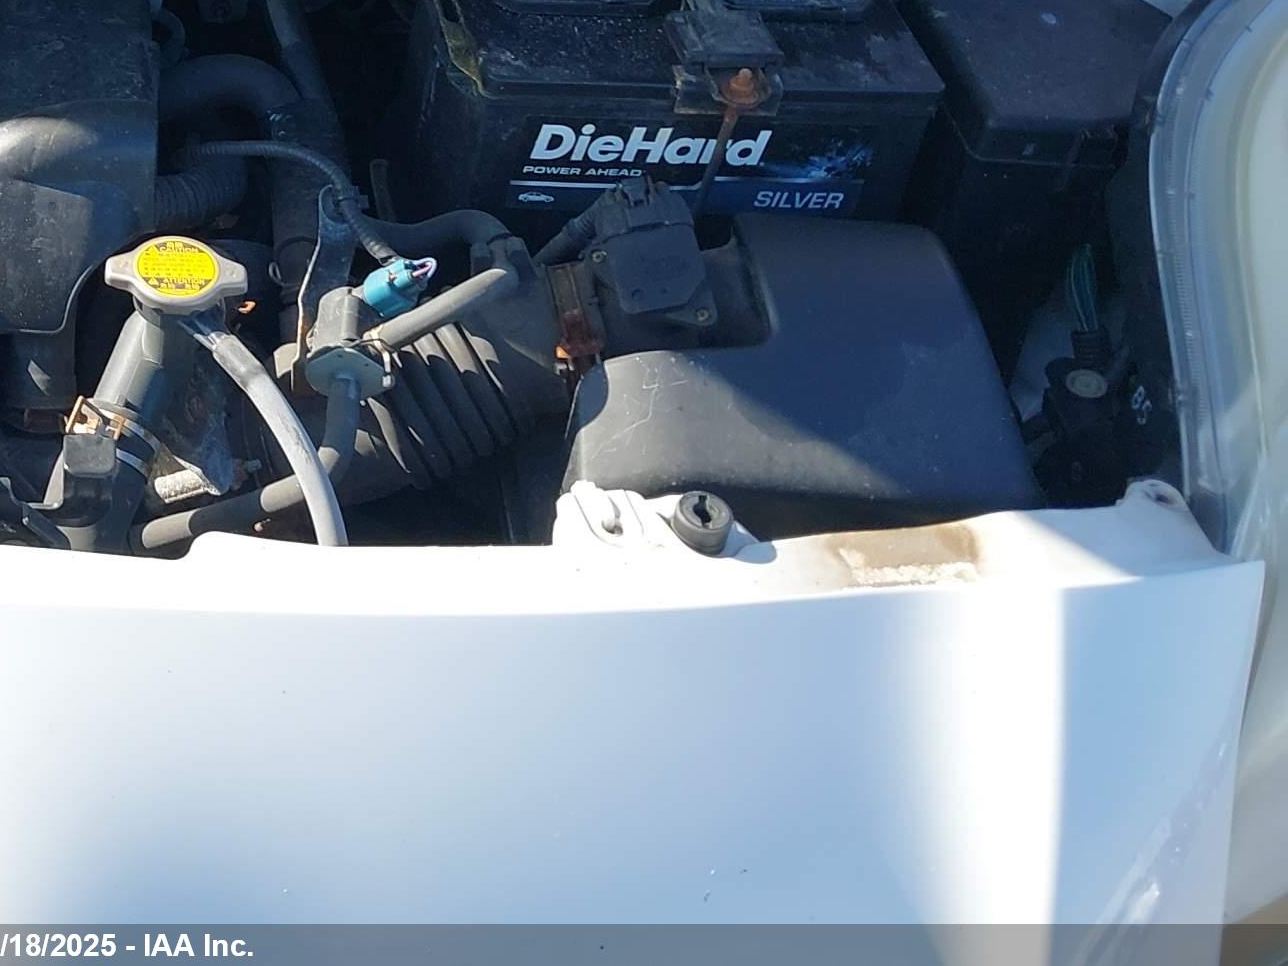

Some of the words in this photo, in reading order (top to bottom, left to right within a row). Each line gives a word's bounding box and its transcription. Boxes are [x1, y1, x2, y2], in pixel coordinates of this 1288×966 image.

[529, 124, 772, 166] DieHard
[523, 165, 581, 176] POWER
[753, 190, 844, 210] SILVER
